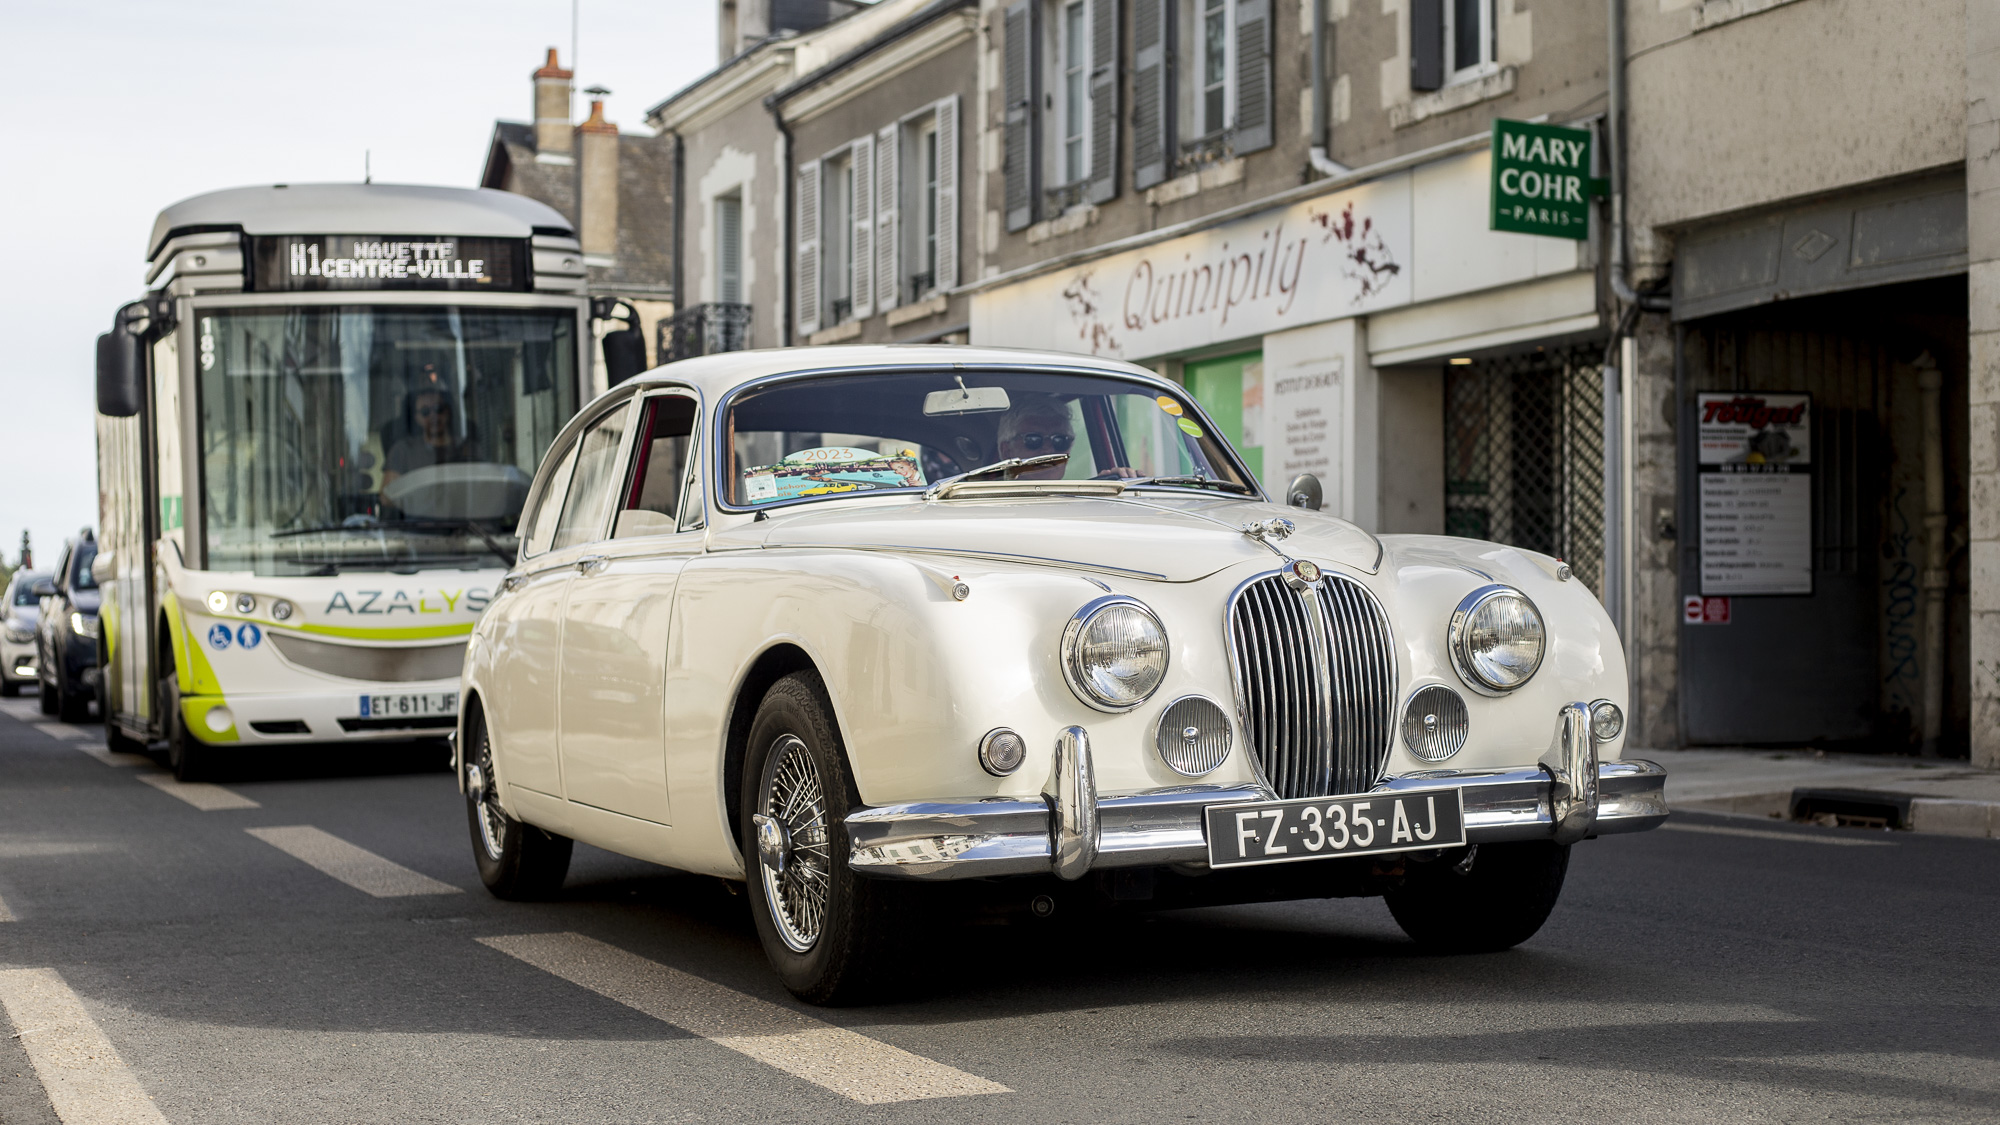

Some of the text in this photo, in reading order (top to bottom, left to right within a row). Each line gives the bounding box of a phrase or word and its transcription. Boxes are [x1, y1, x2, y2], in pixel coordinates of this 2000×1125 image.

[1502, 132, 1586, 168] MARY
[1499, 168, 1584, 203] COHR
[290, 243, 321, 276] H1
[353, 242, 454, 260] NAVETTE
[321, 258, 484, 279] CENTRE-VILLE
[1122, 220, 1308, 331] Quinipily
[803, 448, 854, 462] 2023
[372, 692, 456, 715] ET-611-JF
[1236, 796, 1437, 858] FZ-335-AJ
